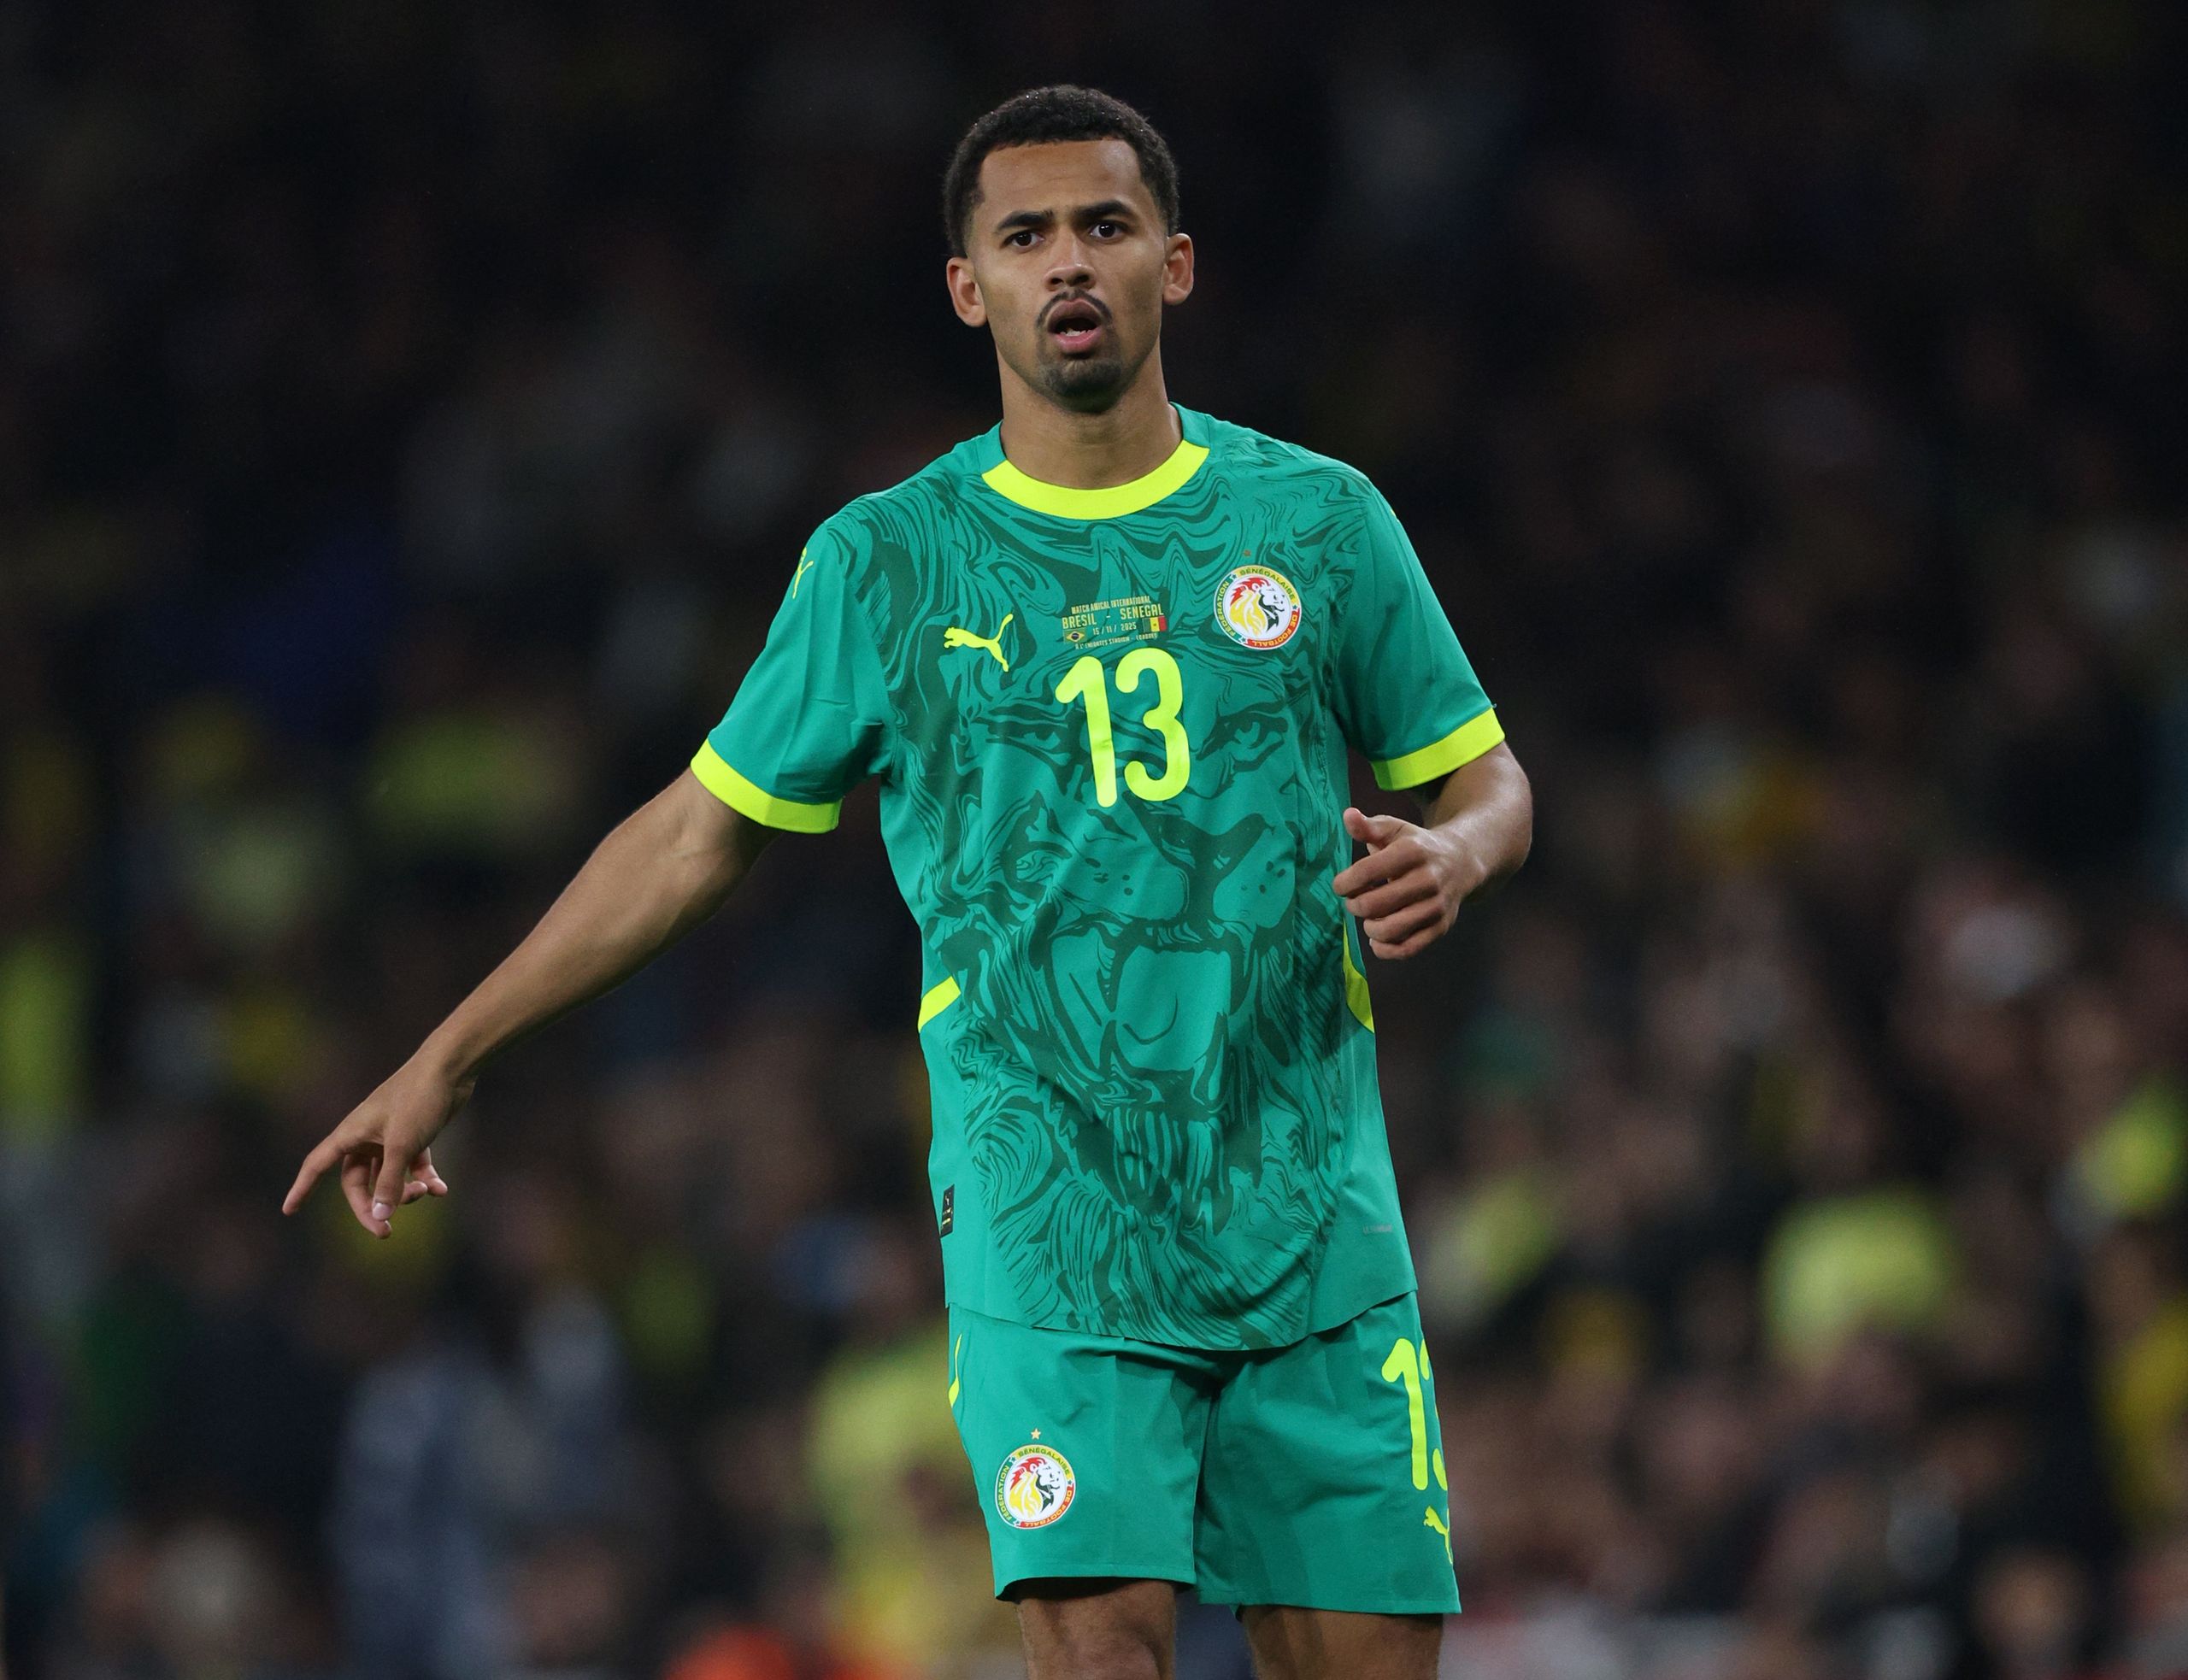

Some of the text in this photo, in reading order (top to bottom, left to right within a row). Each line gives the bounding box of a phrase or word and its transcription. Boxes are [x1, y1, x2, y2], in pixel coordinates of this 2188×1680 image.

[1062, 613, 1097, 629] BRESIL
[1120, 603, 1164, 620] SENEGAL
[1071, 596, 1151, 614] MATCH AMICAL INTERNATIONAL
[1120, 621, 1137, 631] 2025
[1252, 614, 1297, 647] DE FOOTBALL
[1055, 647, 1191, 808] 13
[1025, 1490, 1073, 1526] DE FOOTBALL
